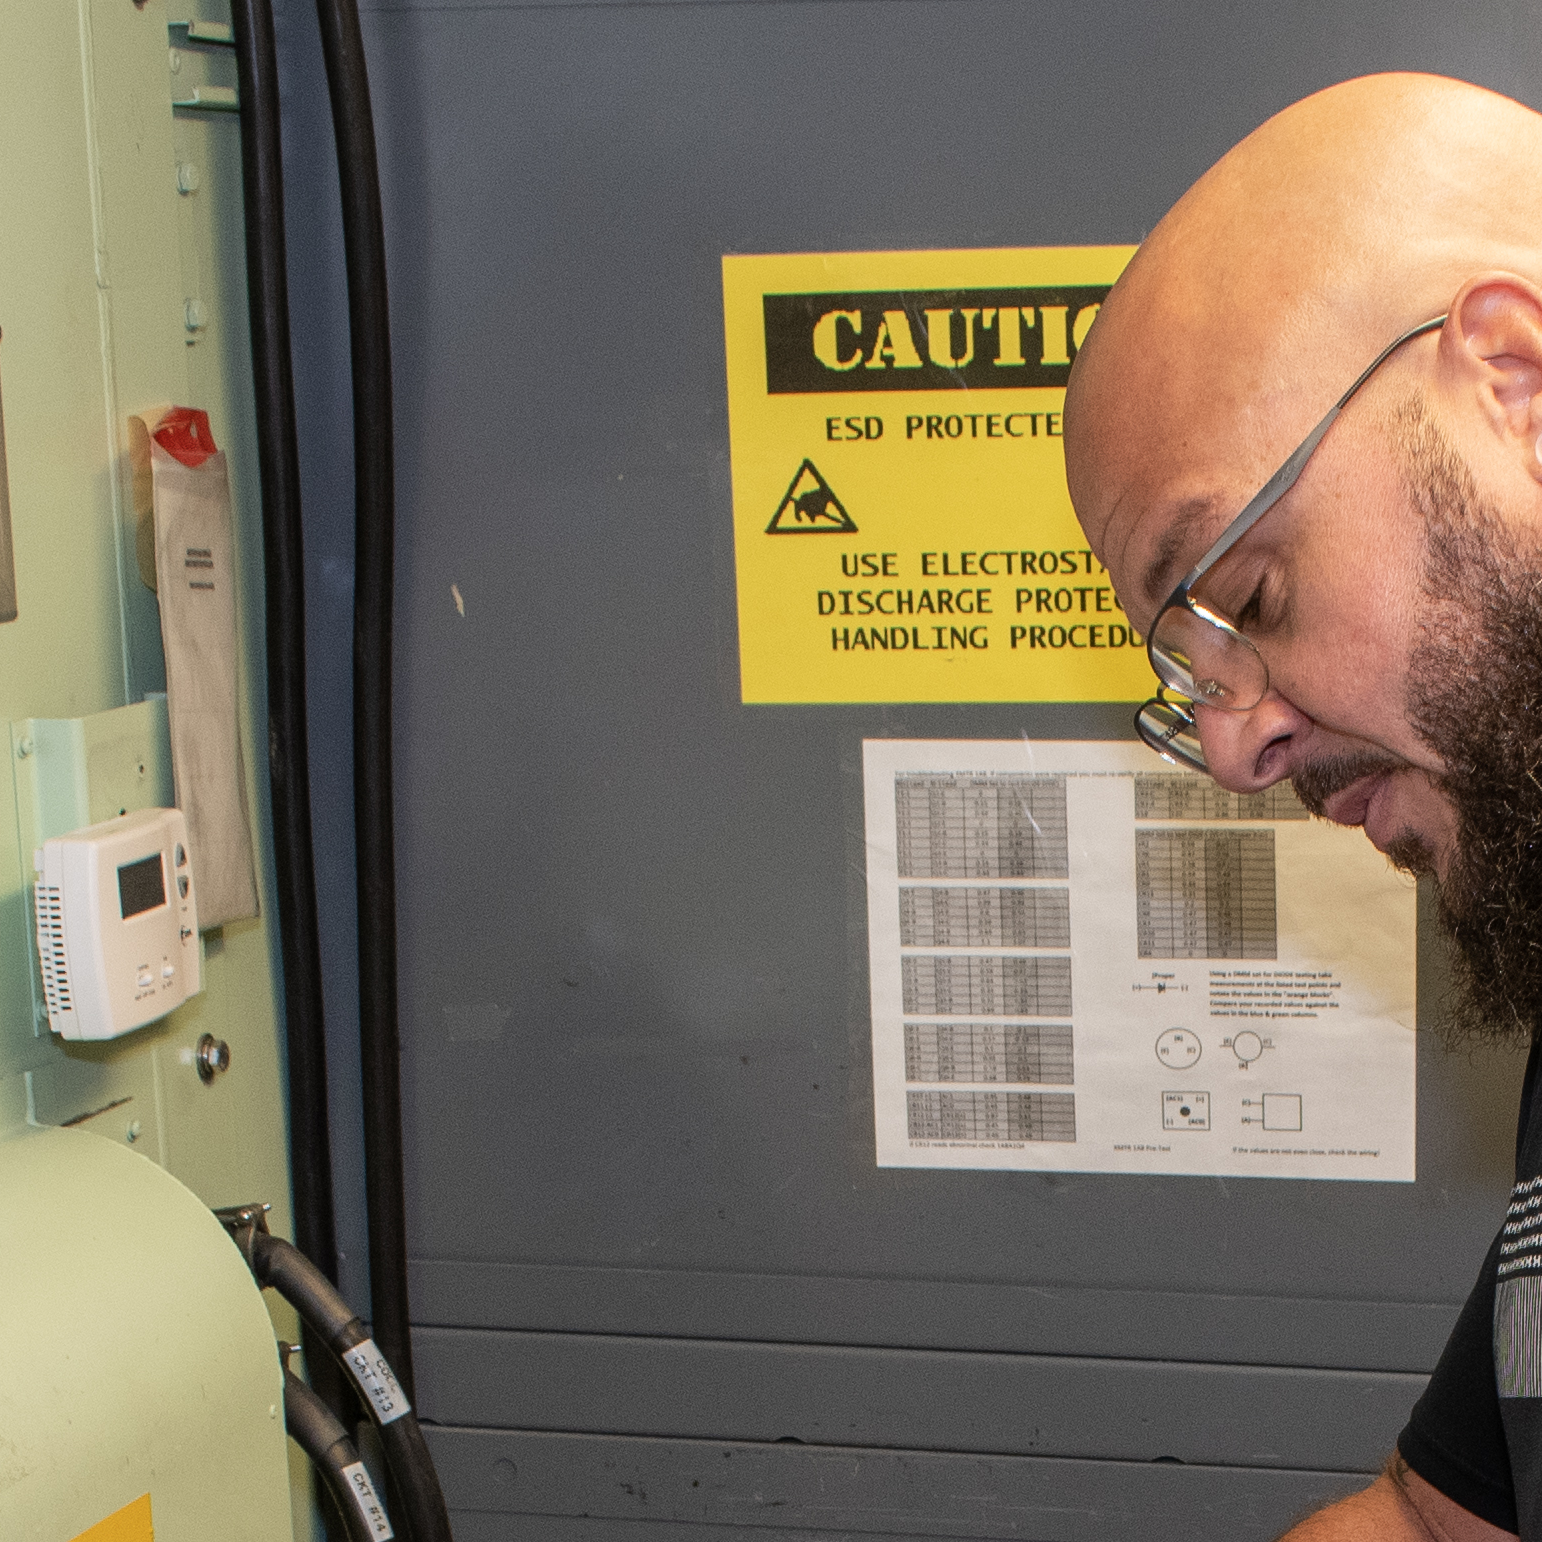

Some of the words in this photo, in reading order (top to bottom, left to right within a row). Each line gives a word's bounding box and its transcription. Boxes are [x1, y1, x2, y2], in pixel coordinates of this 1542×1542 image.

[825, 416, 884, 441] ESD
[905, 411, 1063, 440] PROTECTE
[841, 552, 899, 577] USE
[921, 550, 1108, 577] ELECTROST
[817, 588, 993, 616] DISCHARGE
[831, 625, 989, 651] HANDLING
